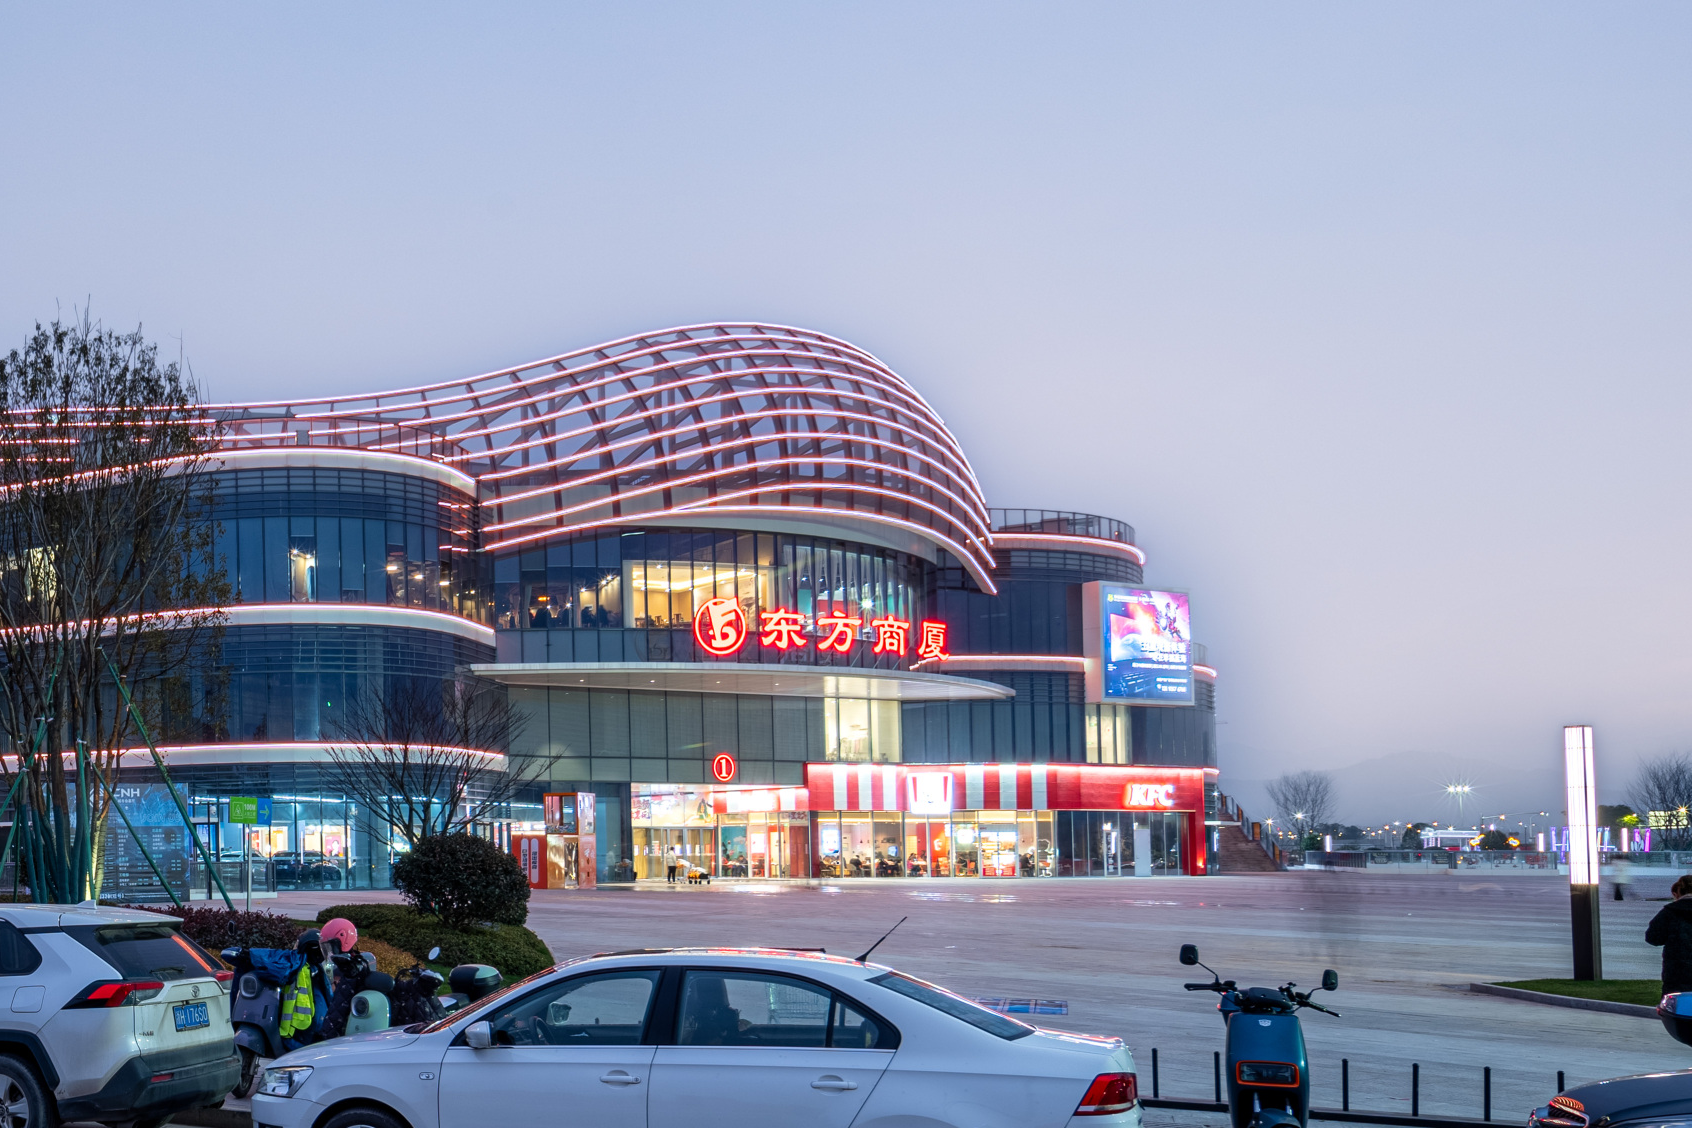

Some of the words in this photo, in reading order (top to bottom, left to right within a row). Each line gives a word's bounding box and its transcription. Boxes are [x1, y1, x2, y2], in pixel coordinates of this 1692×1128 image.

[760, 607, 950, 661] 东方商厦
[1129, 783, 1175, 806] KFC
